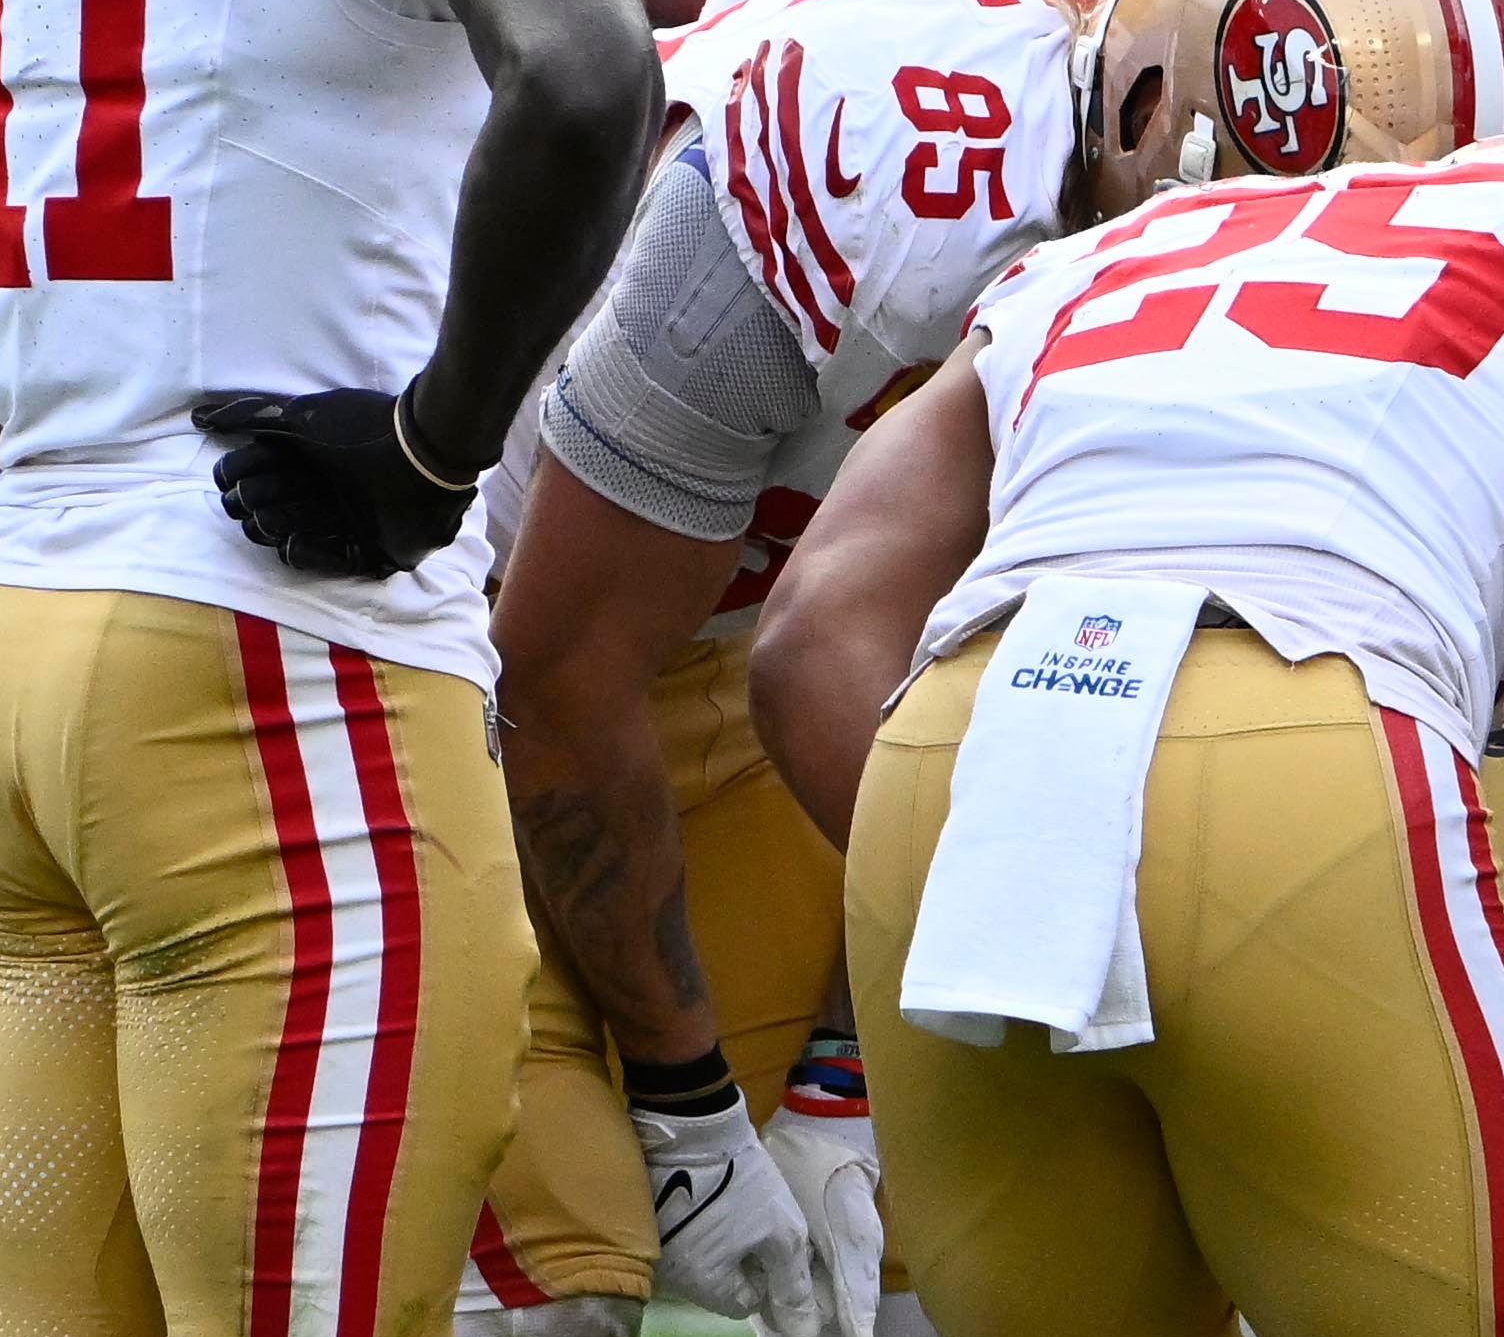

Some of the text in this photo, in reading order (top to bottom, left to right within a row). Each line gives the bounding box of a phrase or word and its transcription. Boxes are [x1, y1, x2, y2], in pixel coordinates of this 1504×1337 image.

[891, 65, 1016, 221] 85
[1078, 629, 1111, 649] NFL
[1040, 650, 1132, 676] INSPIRE
[1010, 667, 1144, 699] CHANGE
